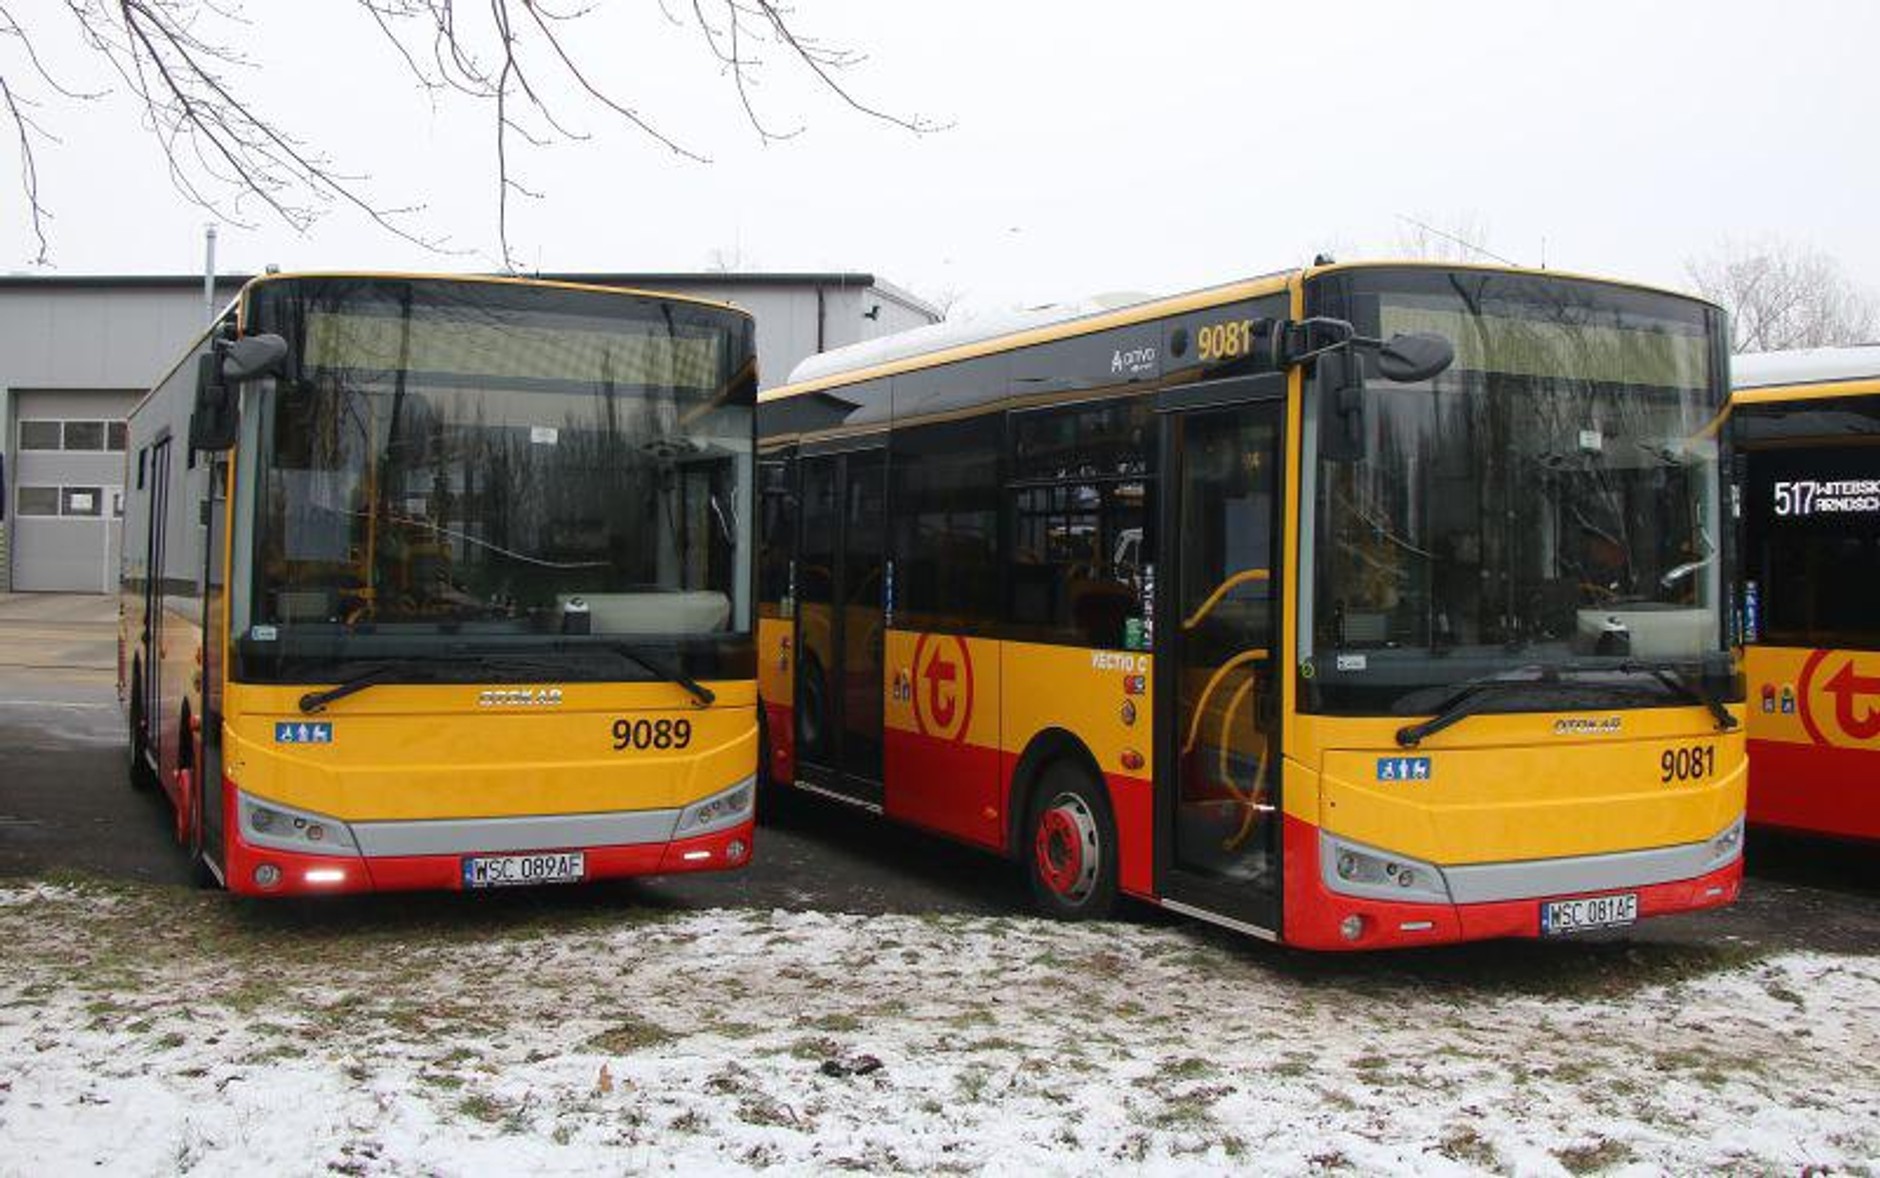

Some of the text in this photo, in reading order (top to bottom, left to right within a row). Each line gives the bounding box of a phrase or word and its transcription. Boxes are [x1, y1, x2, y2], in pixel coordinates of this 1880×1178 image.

[1198, 320, 1251, 359] 9081
[1774, 481, 1815, 515] 517
[479, 687, 563, 706] OTOKAR
[612, 718, 692, 750] 9089
[1555, 717, 1621, 734] OTOKAR
[1661, 745, 1714, 782] 9081
[473, 855, 580, 881] WSC 089AF
[1551, 895, 1635, 926] WSC 081AF
